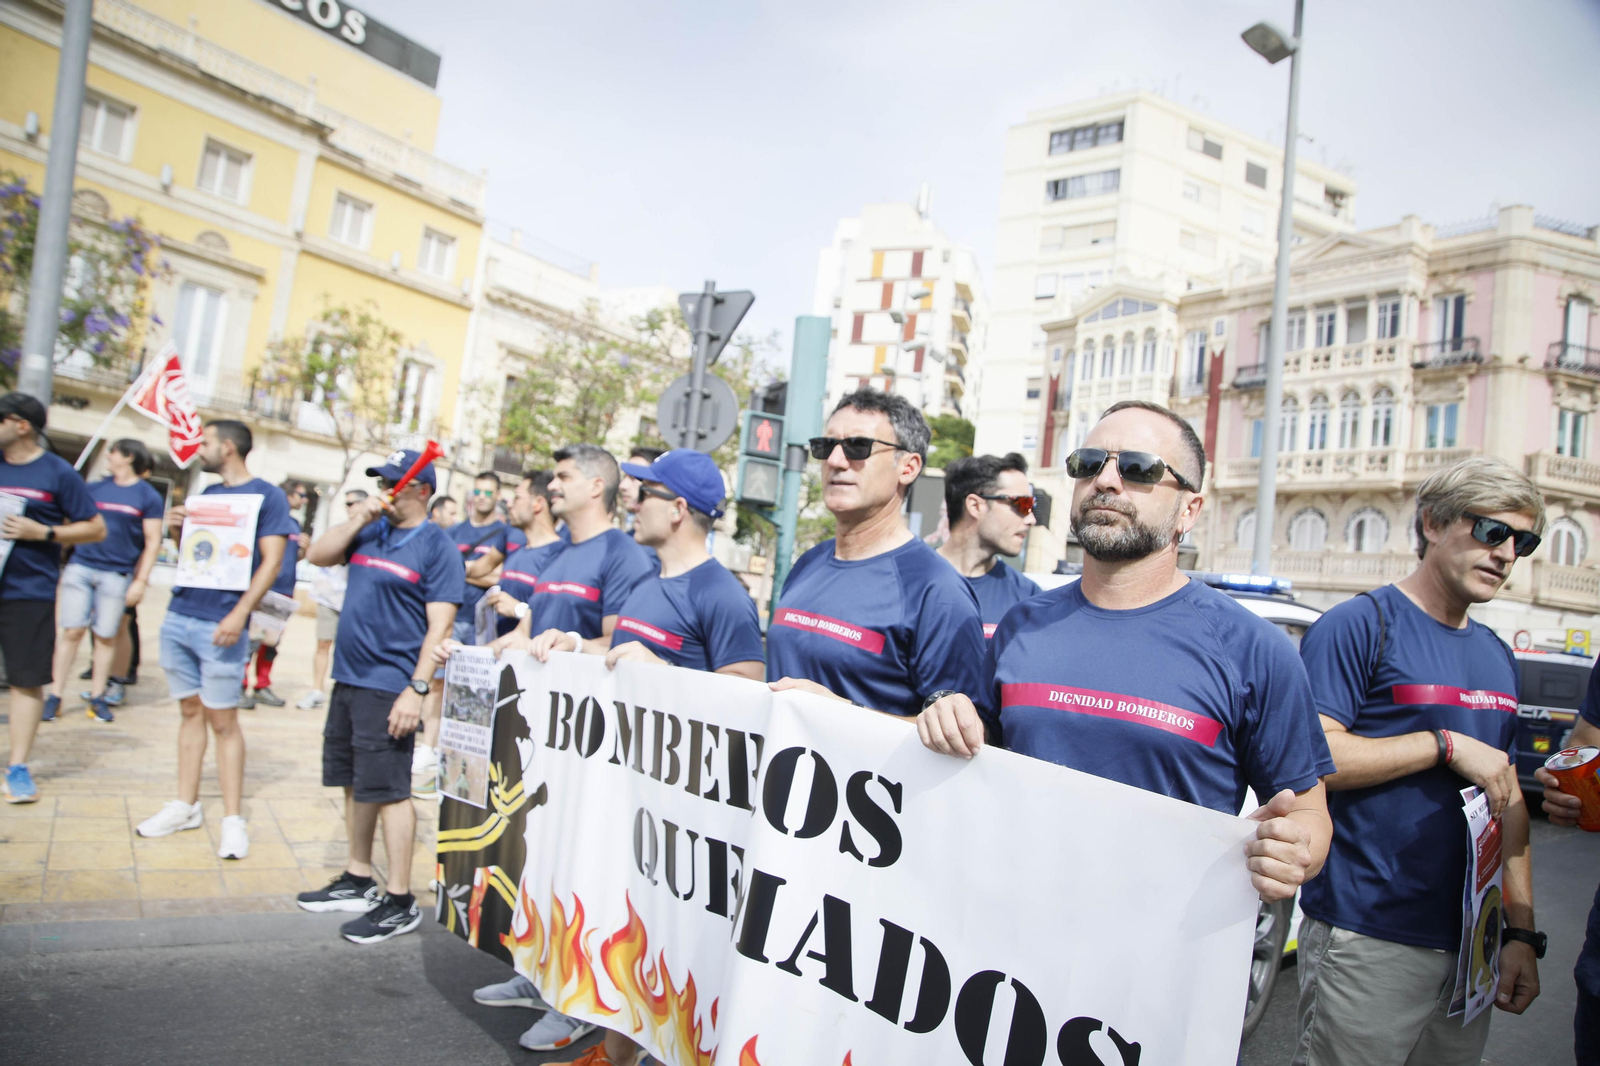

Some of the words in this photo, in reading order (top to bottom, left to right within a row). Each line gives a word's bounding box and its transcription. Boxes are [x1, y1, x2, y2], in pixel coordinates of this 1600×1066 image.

[817, 619, 863, 641] BOMBEROS
[1048, 690, 1114, 710] DIGNIDAD
[1116, 701, 1195, 731] BOMBEROS
[545, 690, 903, 869] BOMBEROS
